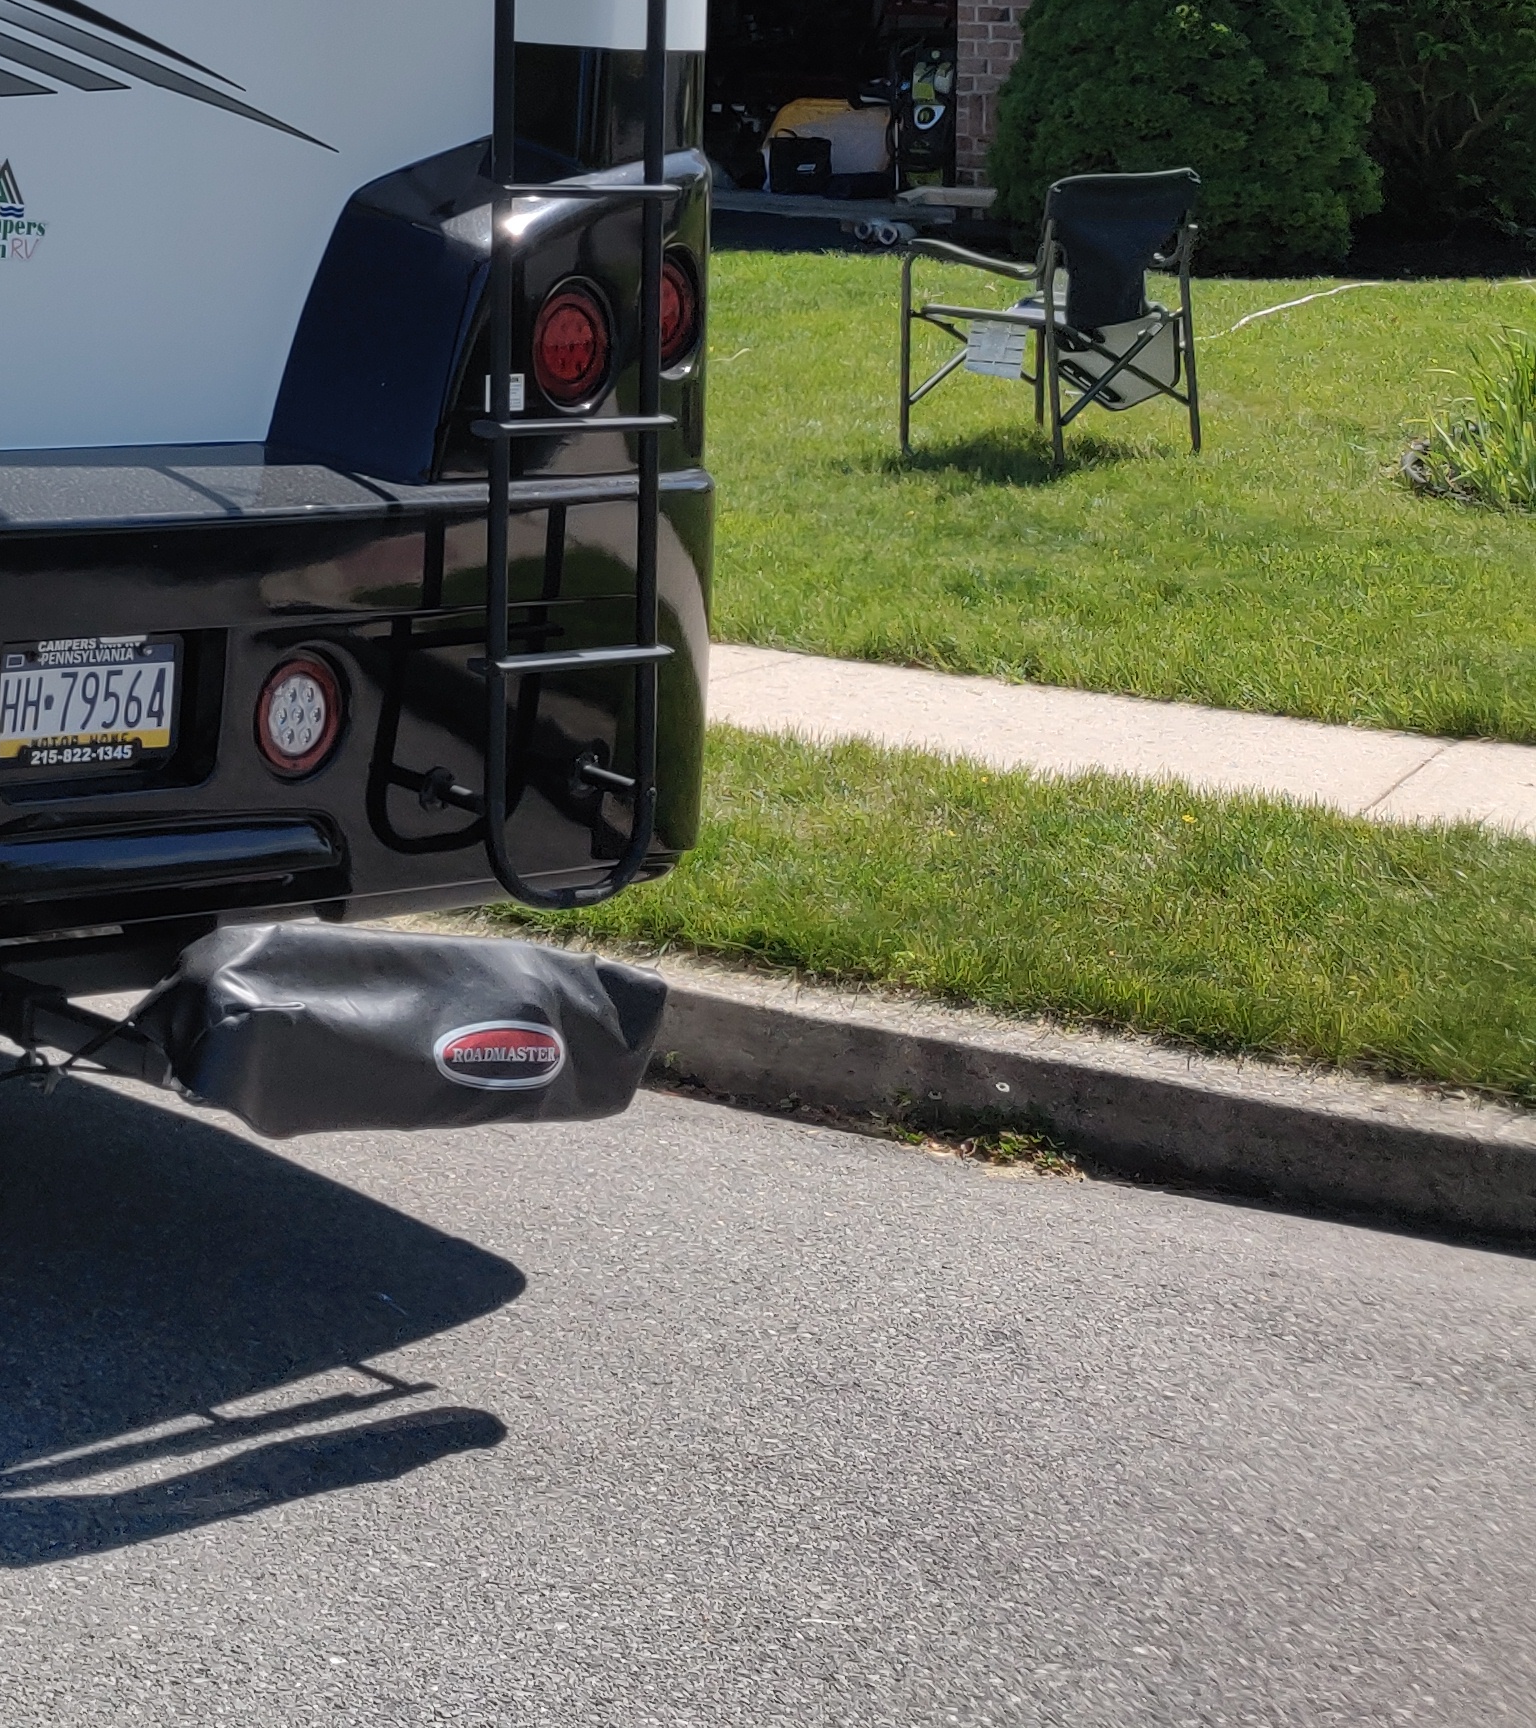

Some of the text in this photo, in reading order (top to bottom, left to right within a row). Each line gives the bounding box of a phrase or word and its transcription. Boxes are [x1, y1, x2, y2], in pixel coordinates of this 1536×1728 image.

[11, 237, 40, 259] RV
[38, 638, 97, 652] CAMPERS
[39, 648, 134, 665] PENNSYLVANIA
[31, 745, 133, 765] 215-822-1345
[452, 1047, 556, 1062] ROADMASTER
